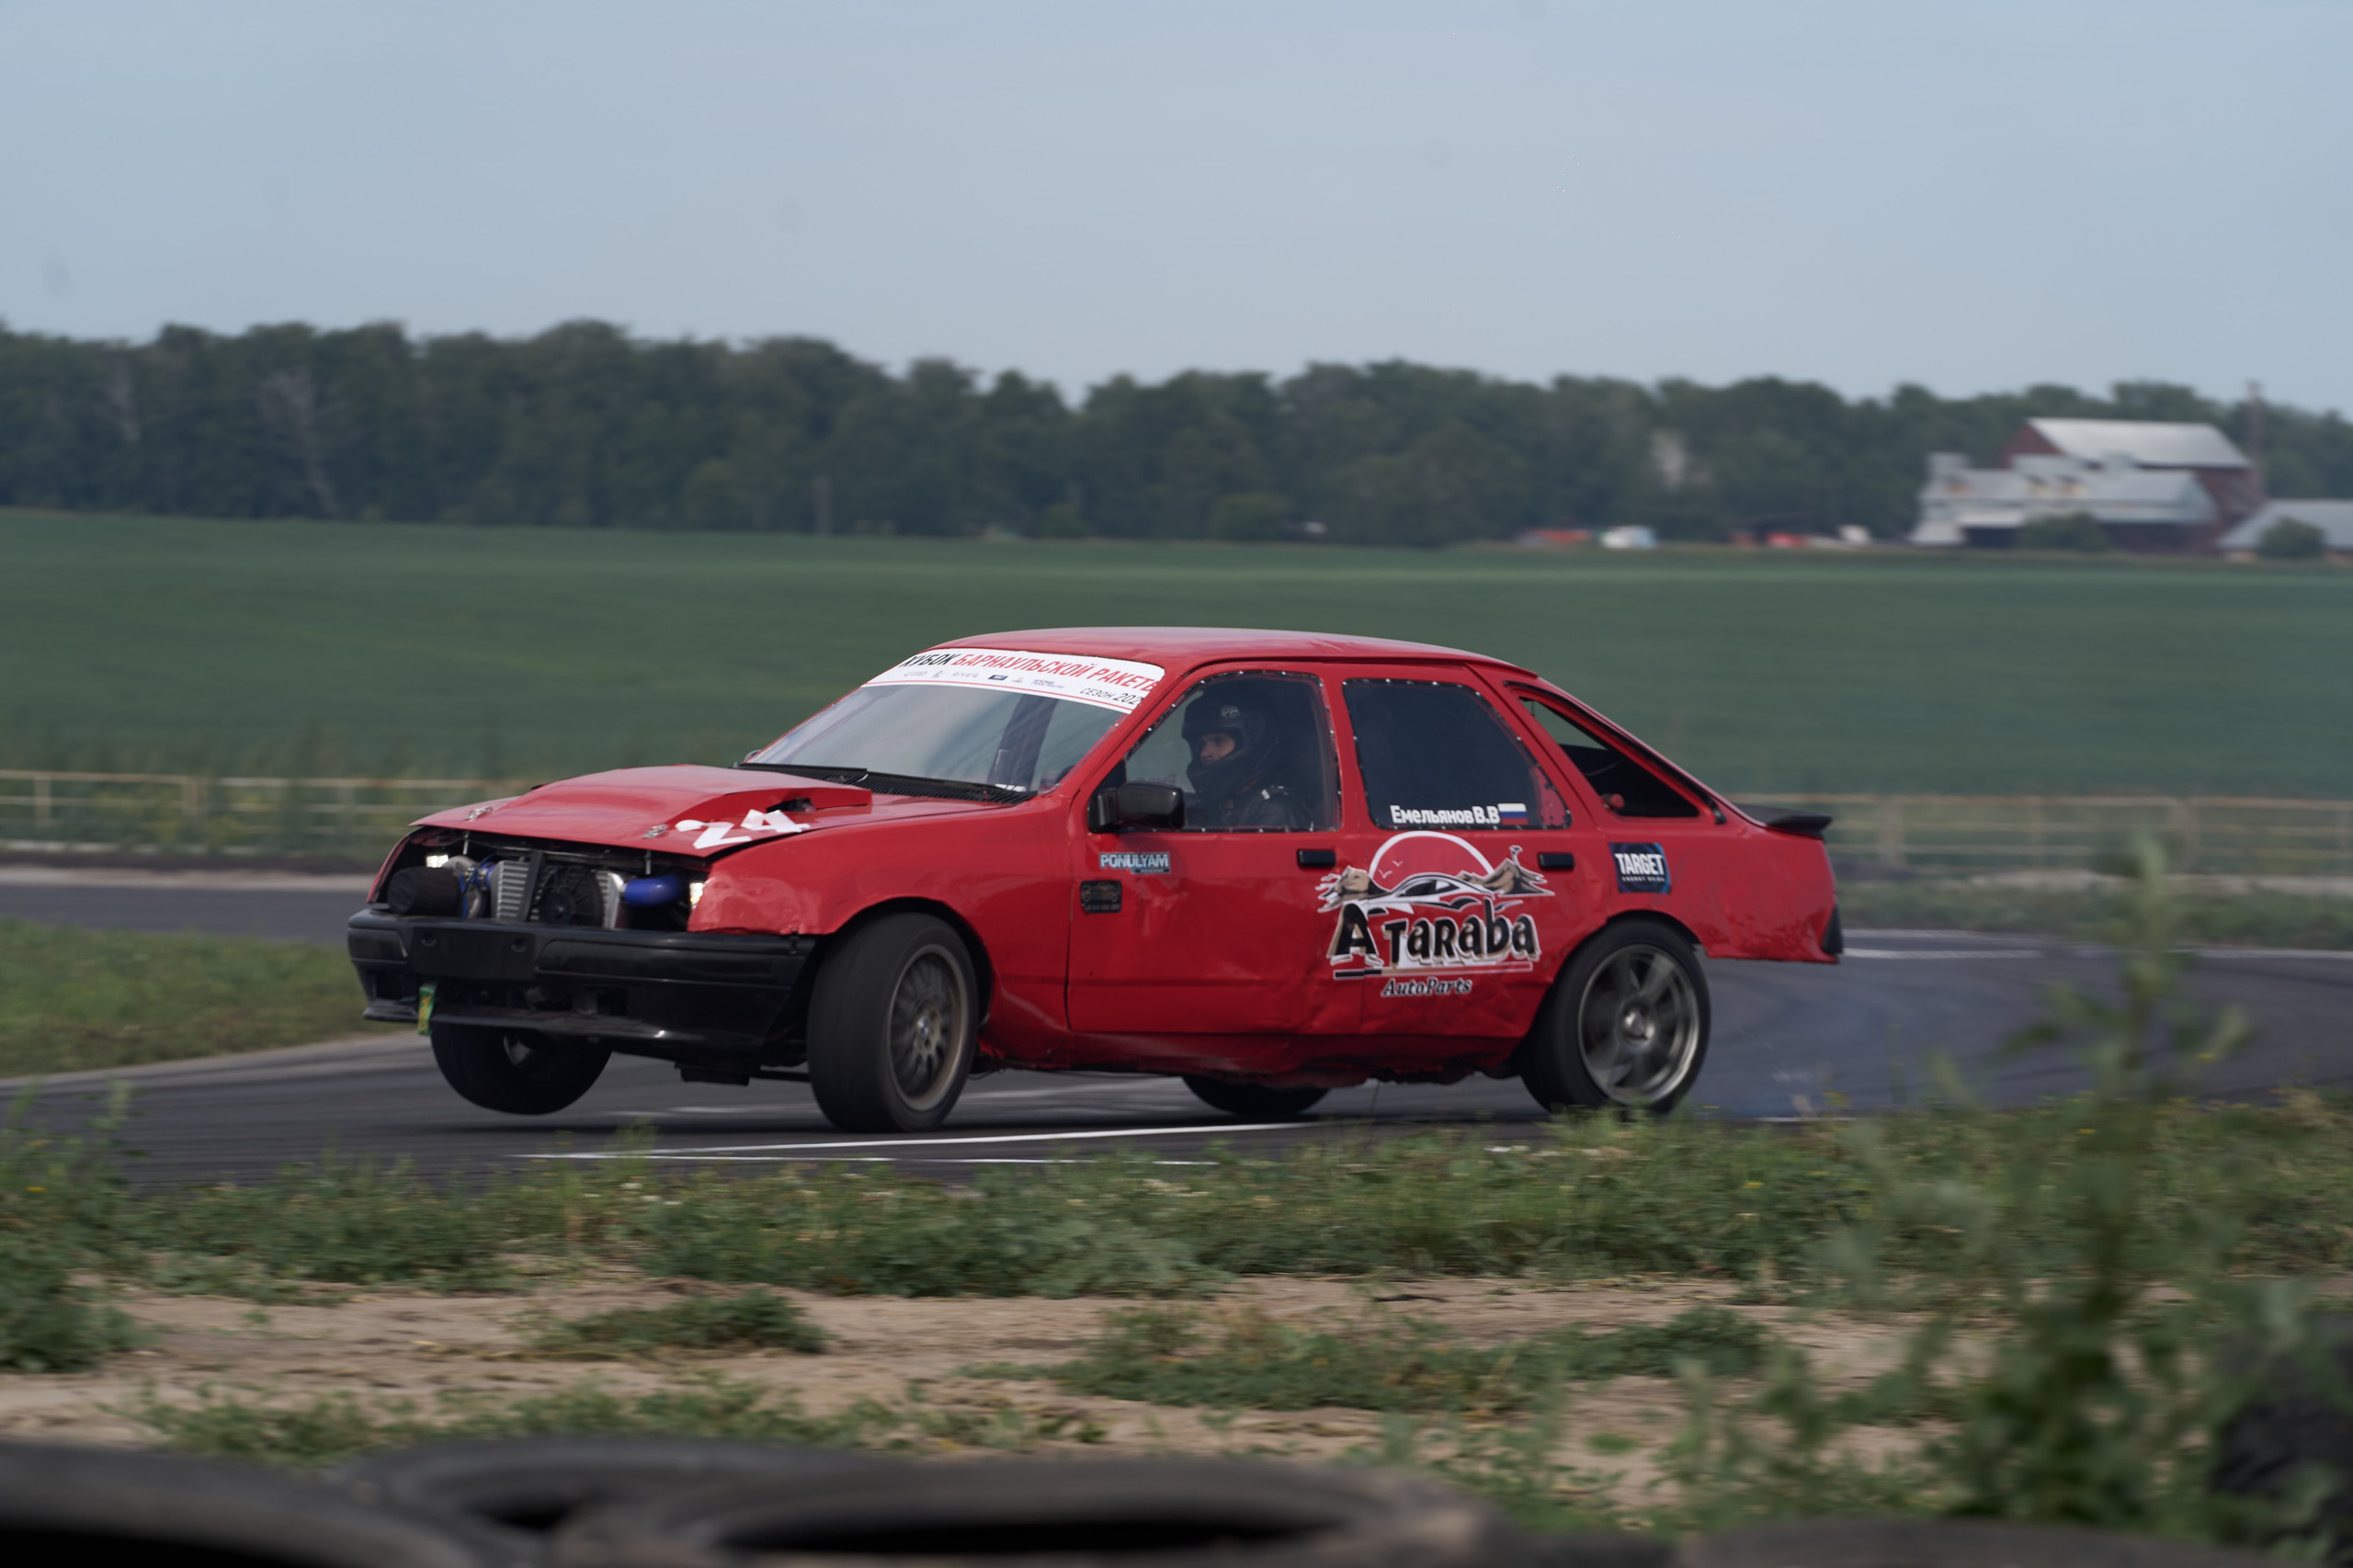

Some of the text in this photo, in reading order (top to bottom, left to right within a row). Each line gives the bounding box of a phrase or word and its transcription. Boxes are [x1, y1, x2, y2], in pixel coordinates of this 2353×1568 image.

[951, 653, 1098, 677] БАРНАУЛЬСКОЙ
[1080, 687, 1117, 699] СЕЗОН
[675, 809, 811, 849] 24
[1099, 853, 1169, 869] PONULYAM
[1614, 853, 1665, 875] TARGET
[1381, 976, 1472, 997] AutoParts
